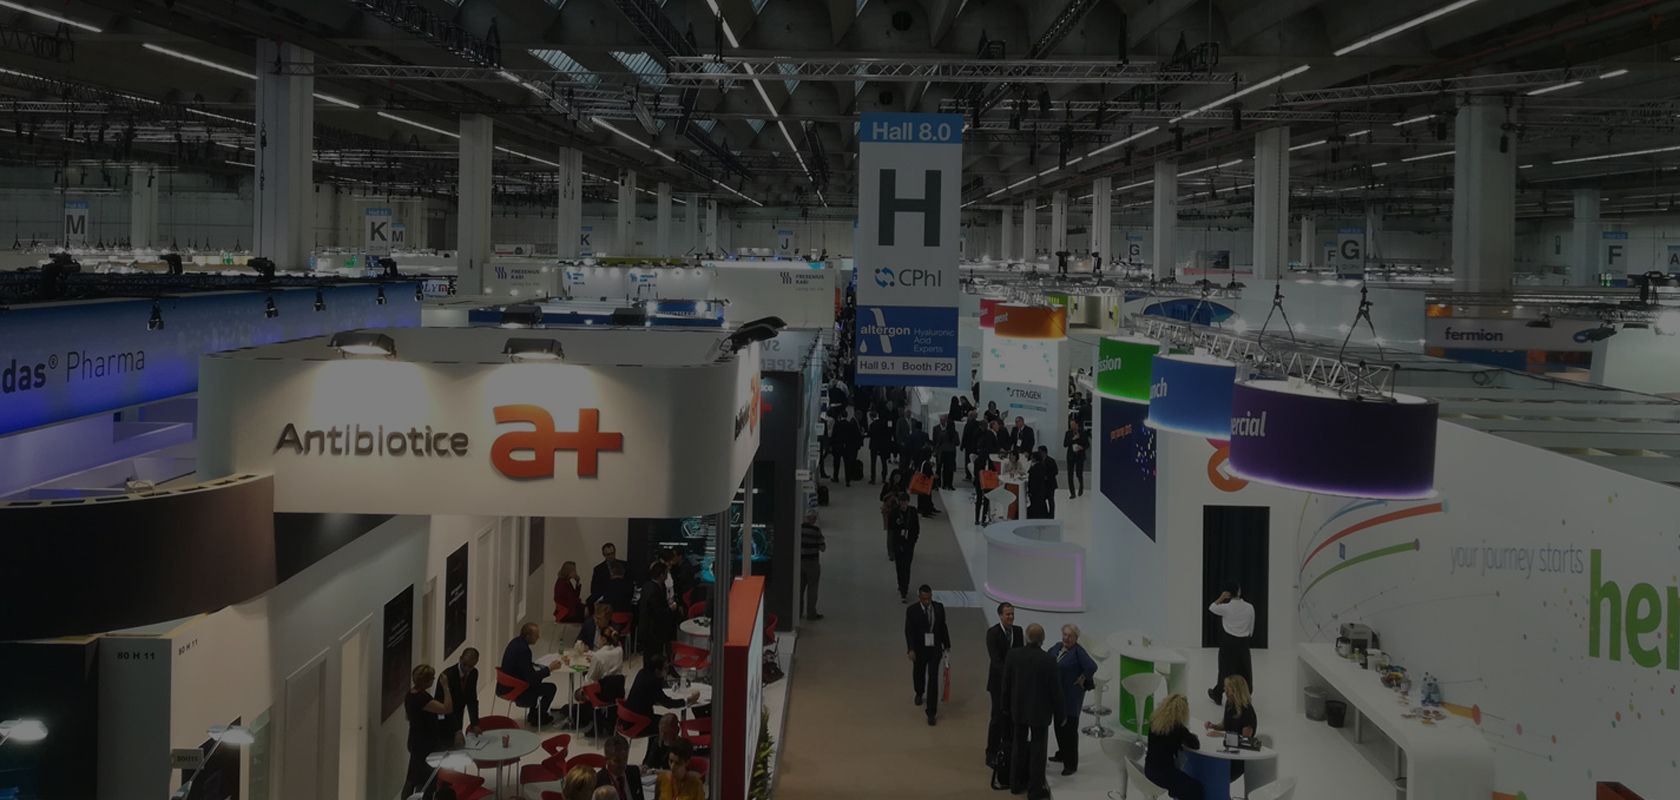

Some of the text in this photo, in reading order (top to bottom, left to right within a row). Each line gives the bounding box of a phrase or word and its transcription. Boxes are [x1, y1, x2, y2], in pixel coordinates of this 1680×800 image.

[872, 122, 951, 141] Hall 8.0
[878, 169, 941, 247] H
[66, 215, 85, 234] M
[371, 221, 387, 241] K
[392, 230, 403, 242] M
[580, 233, 590, 246] K
[781, 238, 789, 249] J
[1129, 243, 1140, 256] G
[1341, 239, 1360, 260] G
[1327, 250, 1337, 261] F
[1608, 245, 1623, 265] F
[1669, 253, 1680, 265] A
[898, 269, 942, 287] CPhI
[860, 324, 911, 337] altergon
[913, 328, 956, 338] Hyaluronic
[1444, 327, 1504, 342] fermion
[913, 336, 932, 345] Acid
[913, 344, 943, 354] Experts
[66, 349, 145, 383] Pharma
[860, 361, 953, 371] Hall 9.1 Booth F20
[276, 422, 469, 457] Antibiotice
[1449, 539, 1584, 580] your journey starts
[133, 652, 140, 660] H
[145, 652, 155, 660] 11
